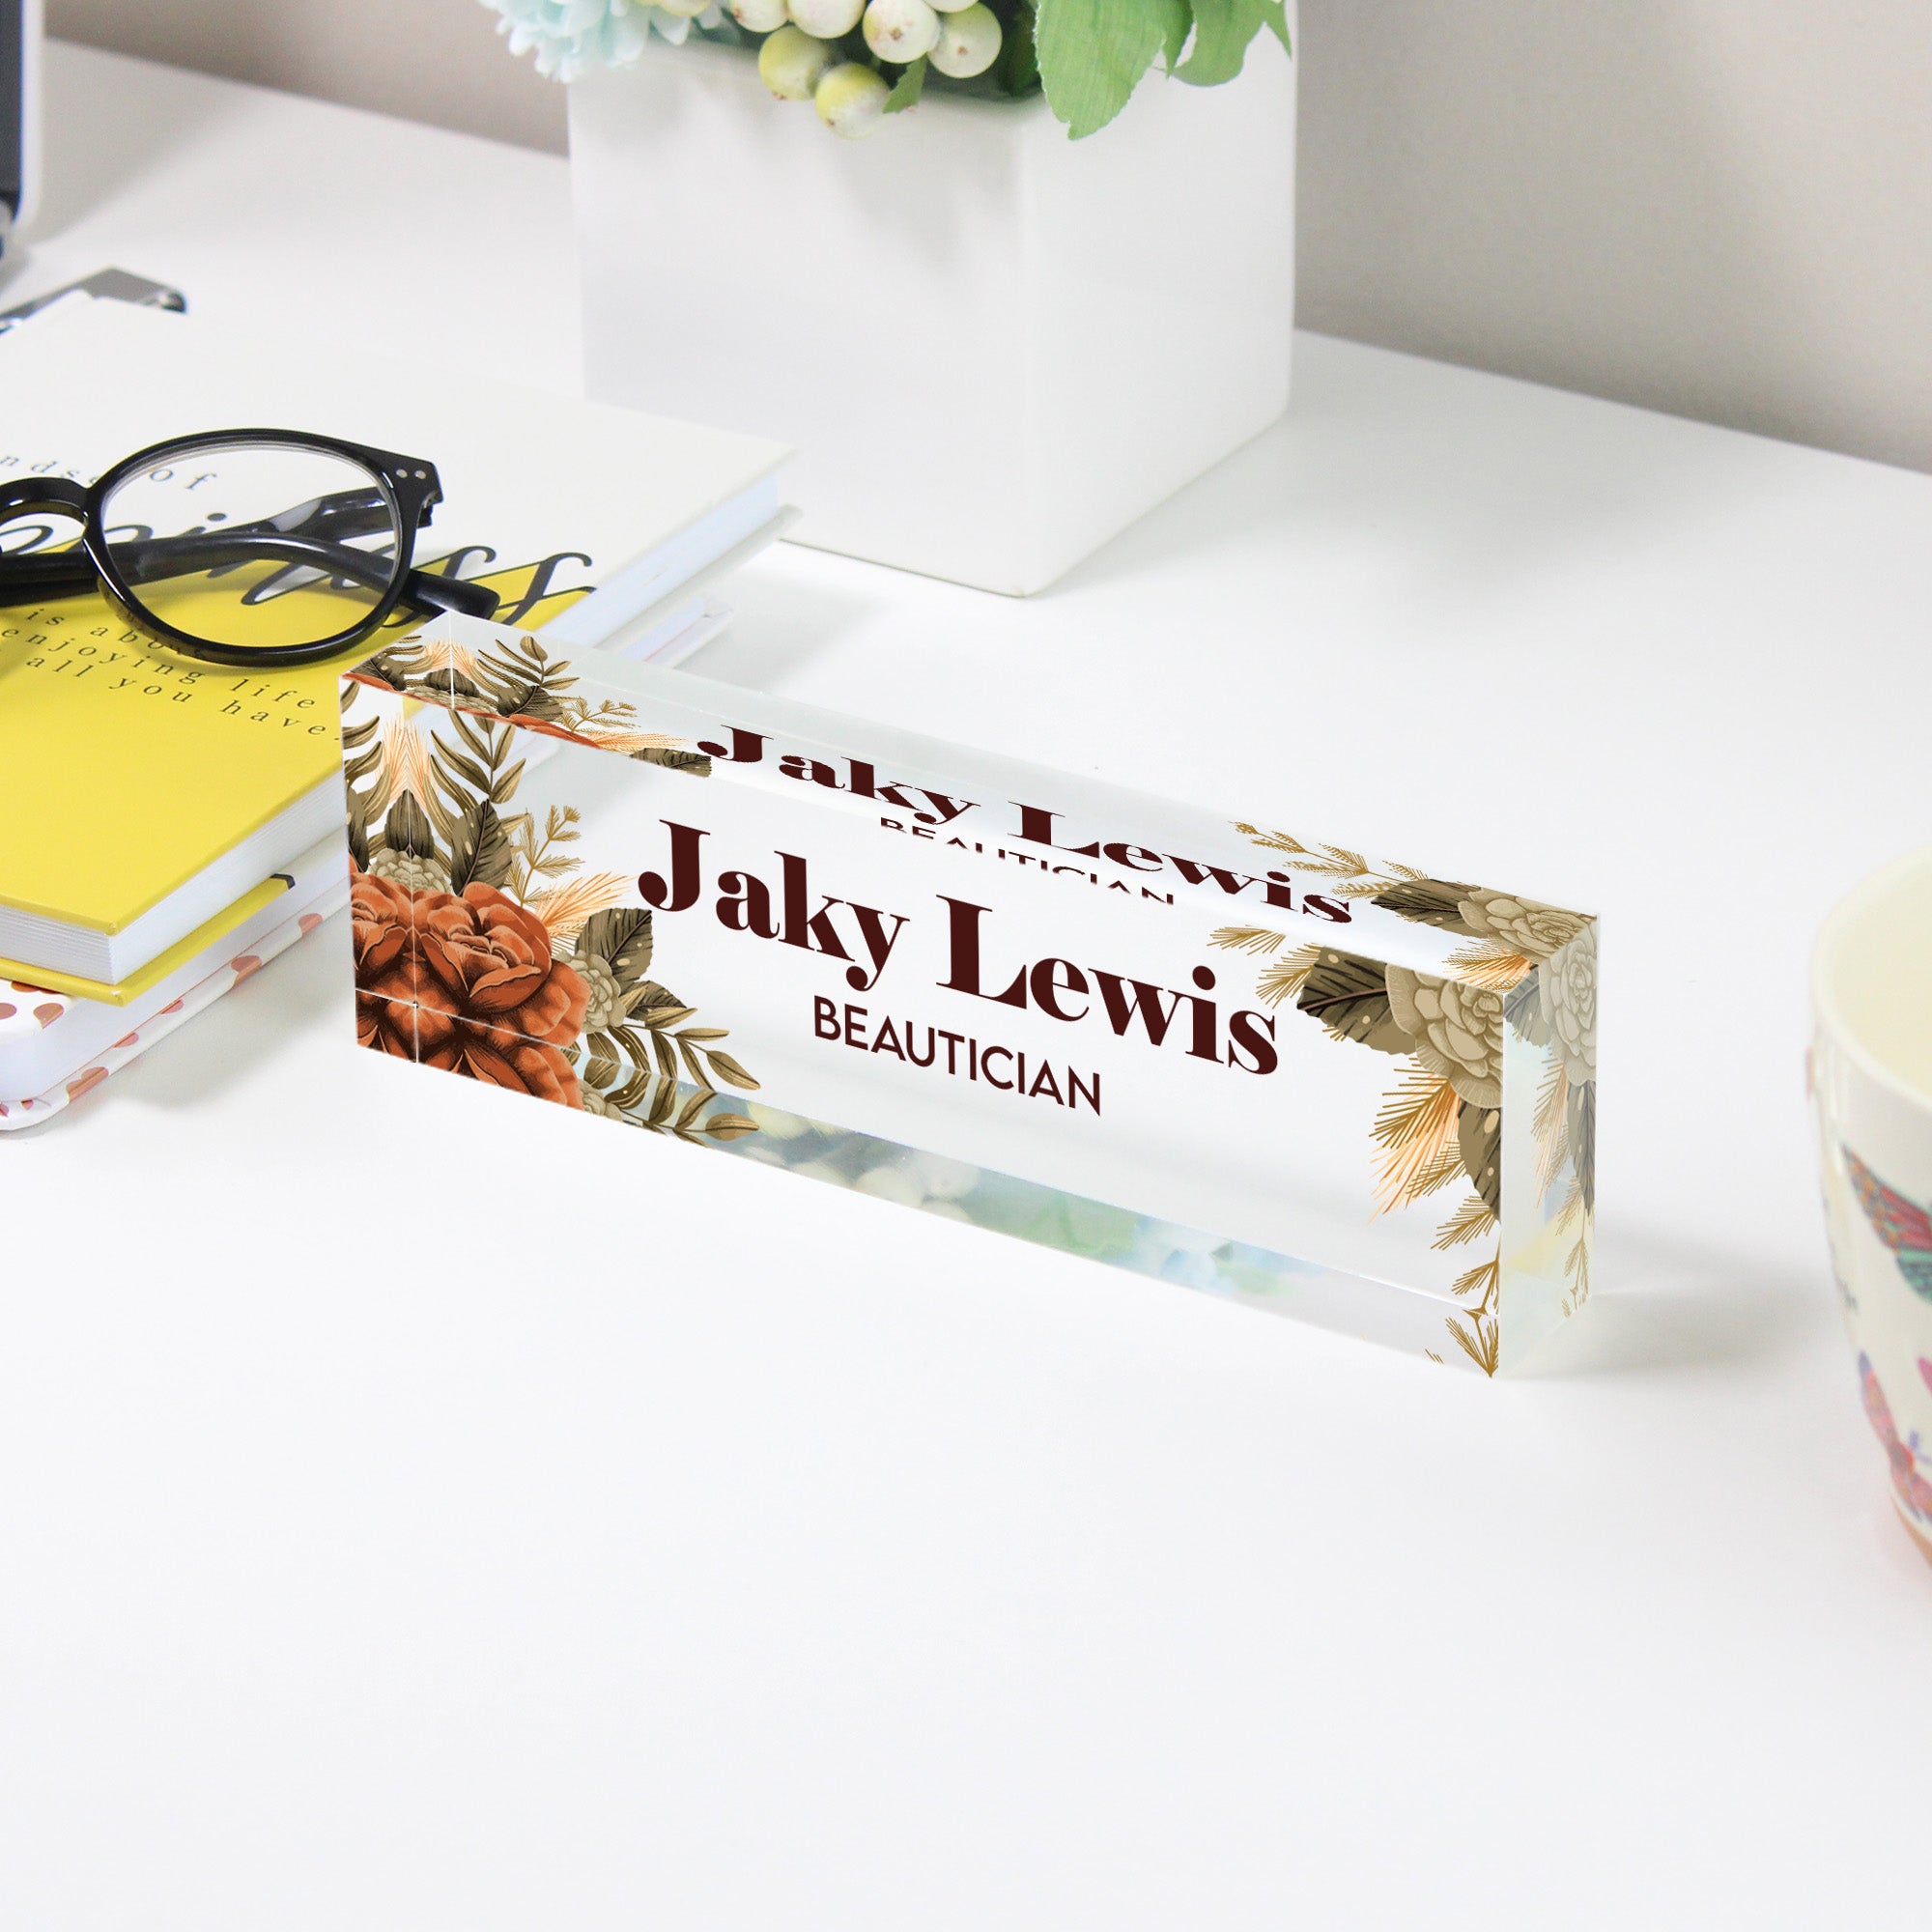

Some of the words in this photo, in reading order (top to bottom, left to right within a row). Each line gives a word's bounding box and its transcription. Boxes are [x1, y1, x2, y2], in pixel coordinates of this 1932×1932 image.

[150, 469, 217, 490] of
[25, 608, 65, 626] is
[2, 628, 204, 685] enjoying
[230, 677, 316, 709] life
[26, 657, 94, 677] all
[108, 677, 192, 702] you
[697, 724, 980, 825] Jaky
[1008, 800, 1352, 923] Lewis
[638, 819, 910, 992] Jaky
[935, 895, 1279, 1076] Lewis
[814, 995, 1101, 1117] BEAUTICIAN
